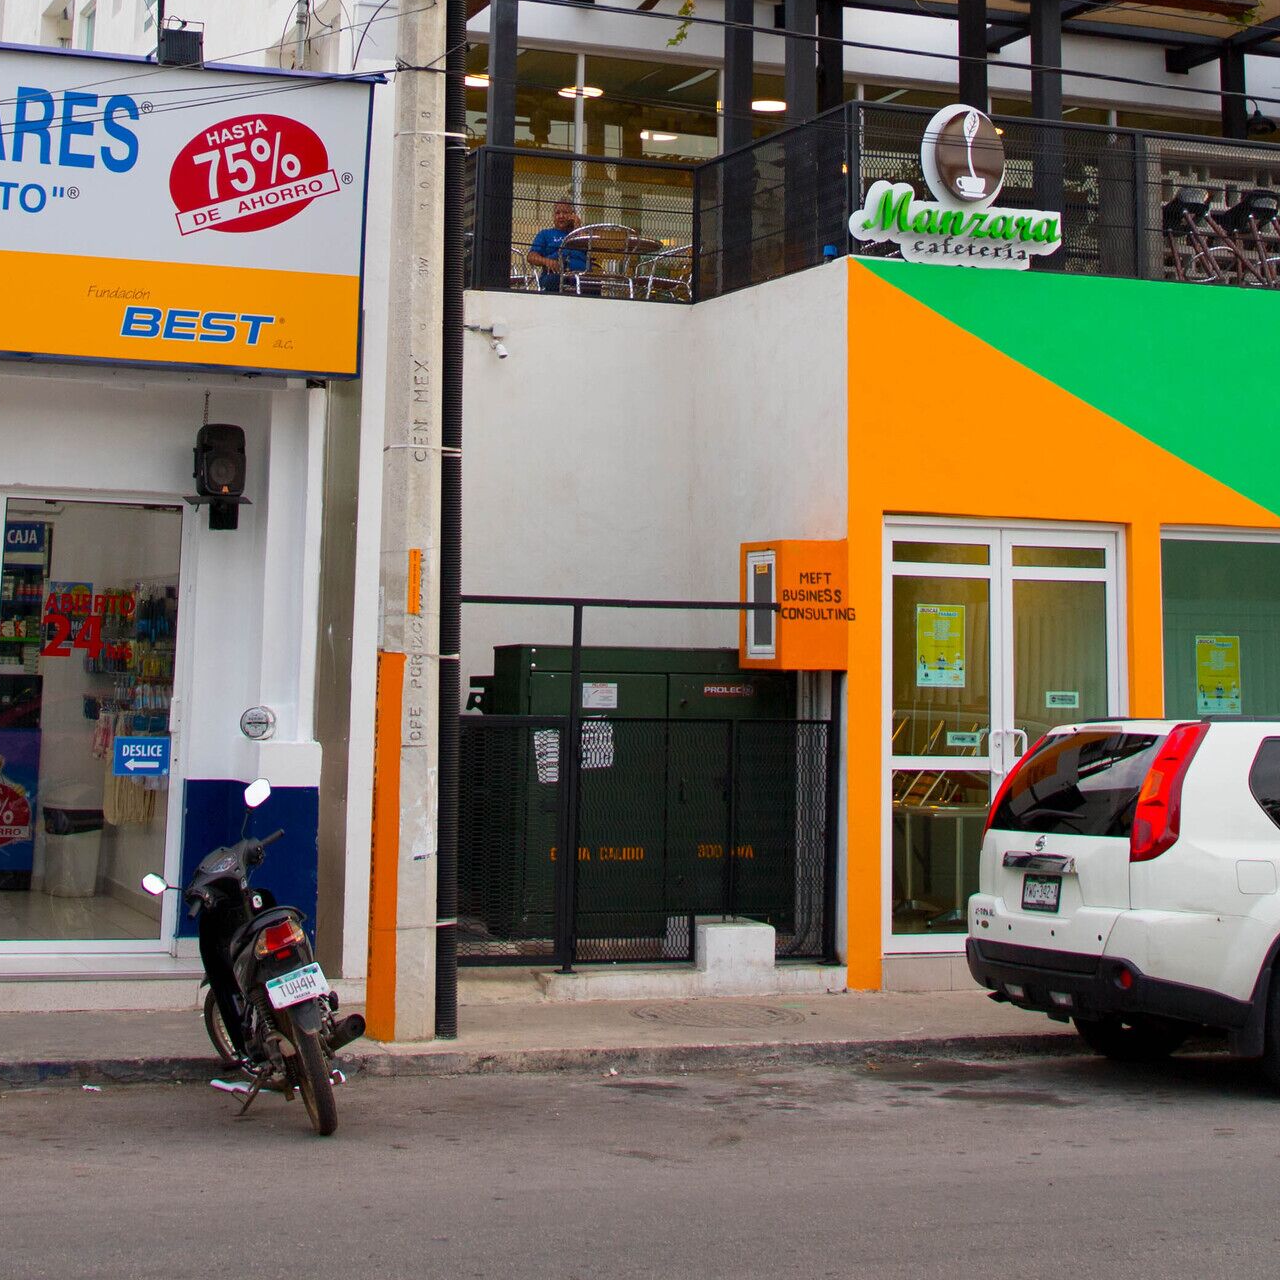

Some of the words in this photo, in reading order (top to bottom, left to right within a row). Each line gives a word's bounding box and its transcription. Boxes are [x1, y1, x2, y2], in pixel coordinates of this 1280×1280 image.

[206, 119, 269, 147] HASTA
[193, 132, 302, 200] 75%
[193, 207, 222, 226] DE
[237, 179, 323, 216] AHORRO
[861, 188, 1062, 244] Manzara
[911, 235, 1029, 261] cafetería
[87, 284, 152, 302] Fundación
[120, 306, 276, 346] BEST
[7, 529, 39, 546] CAJA
[799, 572, 832, 585] MEFT
[44, 592, 136, 616] ABIERTO
[782, 588, 842, 604] BUSINESS
[781, 607, 856, 621] CONSULTING
[40, 614, 104, 660] 24
[704, 686, 742, 694] PROLEC
[122, 744, 163, 757] DESLICE
